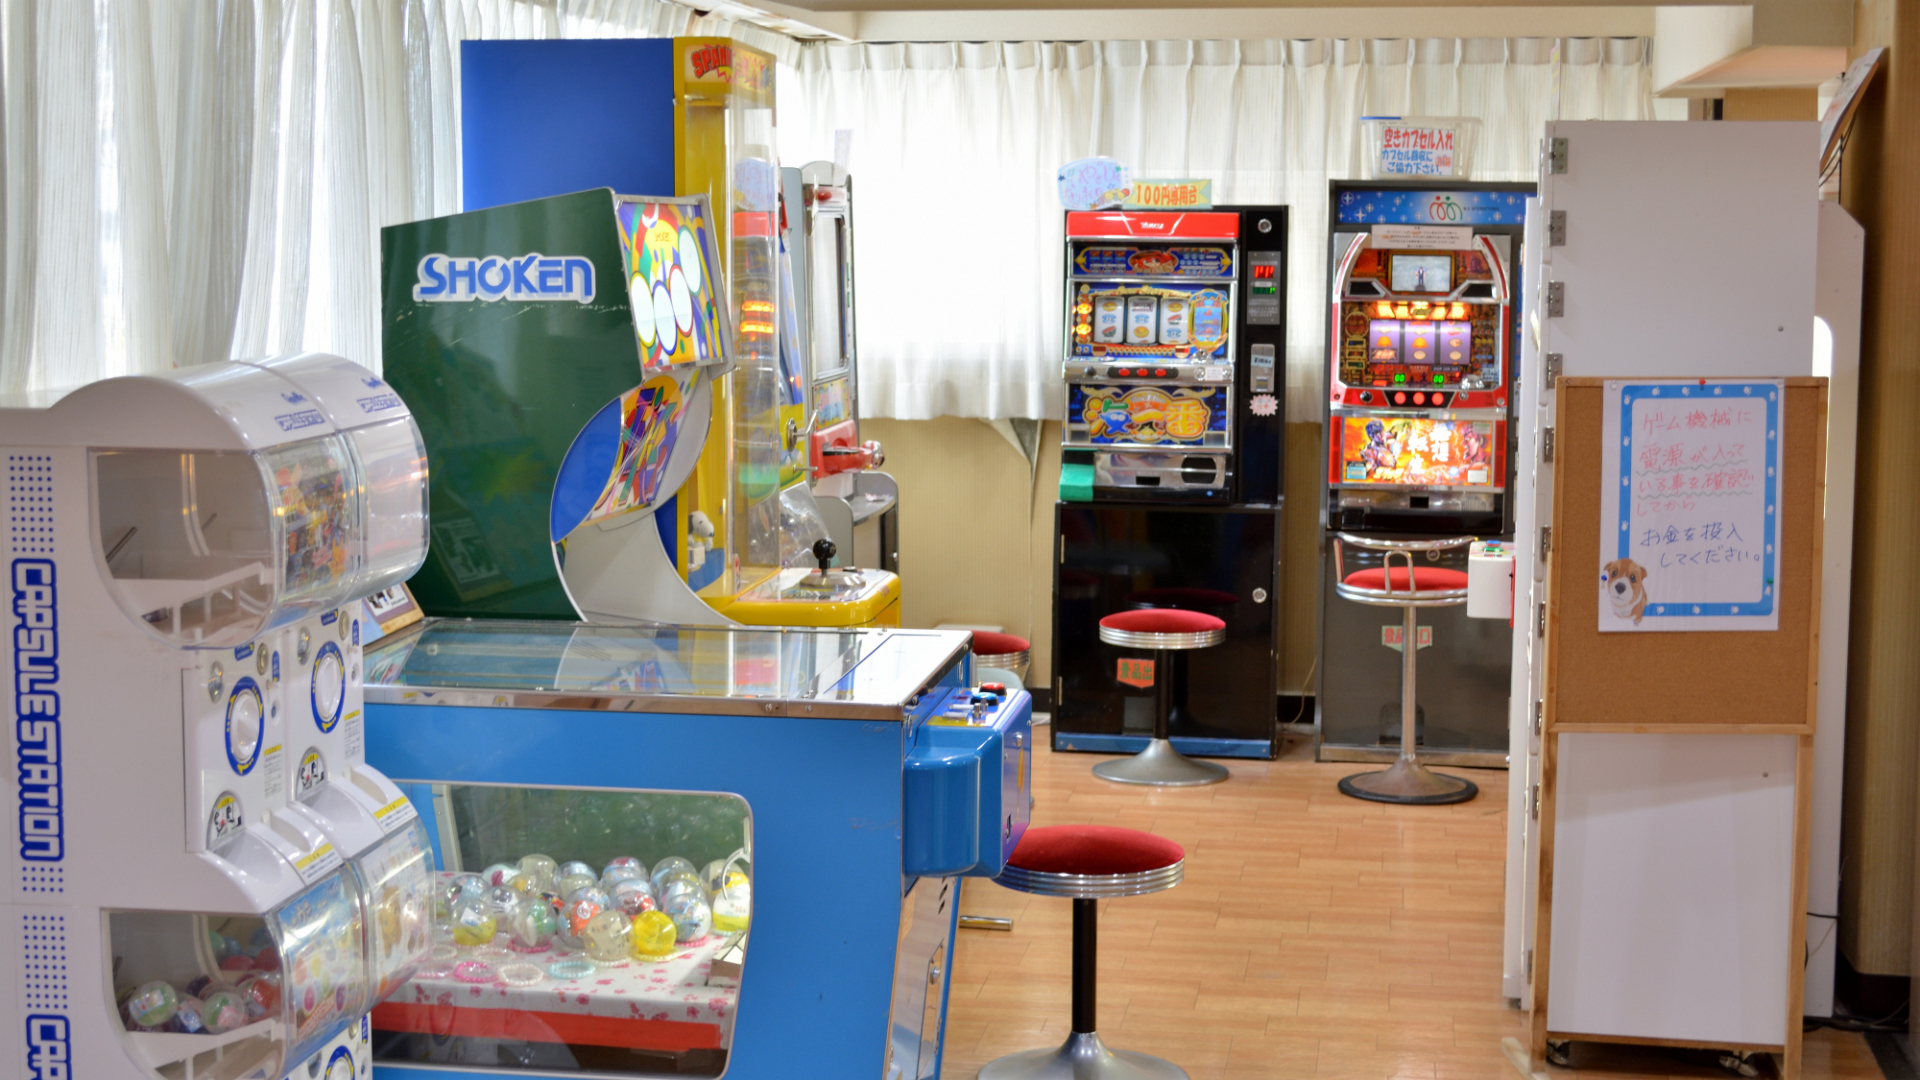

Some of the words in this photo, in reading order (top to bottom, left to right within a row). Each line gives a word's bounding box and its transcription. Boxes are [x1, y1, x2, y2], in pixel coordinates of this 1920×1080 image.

[414, 253, 595, 302] SHOKEN
[1643, 406, 1752, 436] ゲーム機械に
[1639, 443, 1746, 471] 電源が入って
[1639, 468, 1754, 495] いる事を確認
[1637, 496, 1695, 517] してから
[1640, 521, 1743, 547] お金を投入
[1660, 544, 1760, 568] してください。
